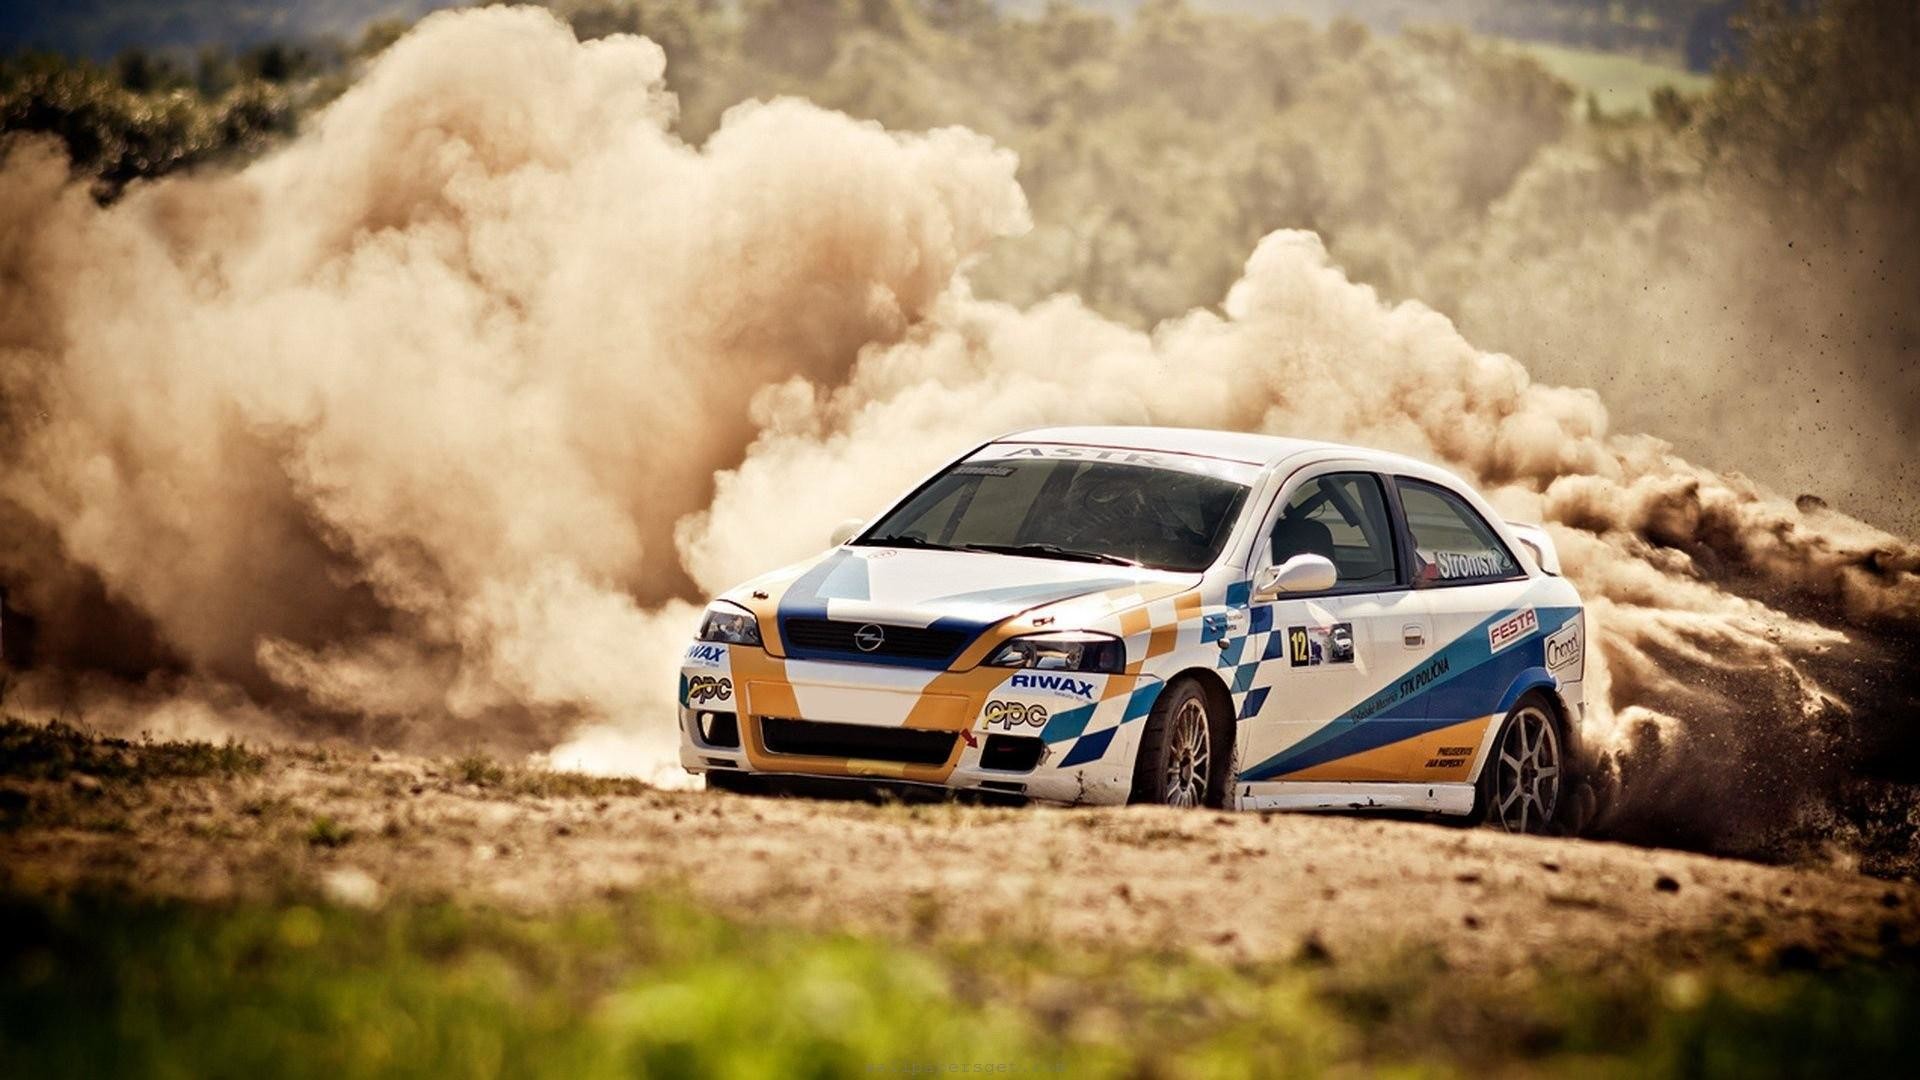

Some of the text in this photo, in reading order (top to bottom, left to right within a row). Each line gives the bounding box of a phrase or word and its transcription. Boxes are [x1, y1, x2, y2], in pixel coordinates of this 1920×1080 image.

[1002, 447, 1170, 467] ASTR
[1491, 609, 1536, 645] FESTA
[1291, 631, 1308, 661] 12
[1011, 675, 1094, 699] RIWAX
[1400, 681, 1416, 699] STK
